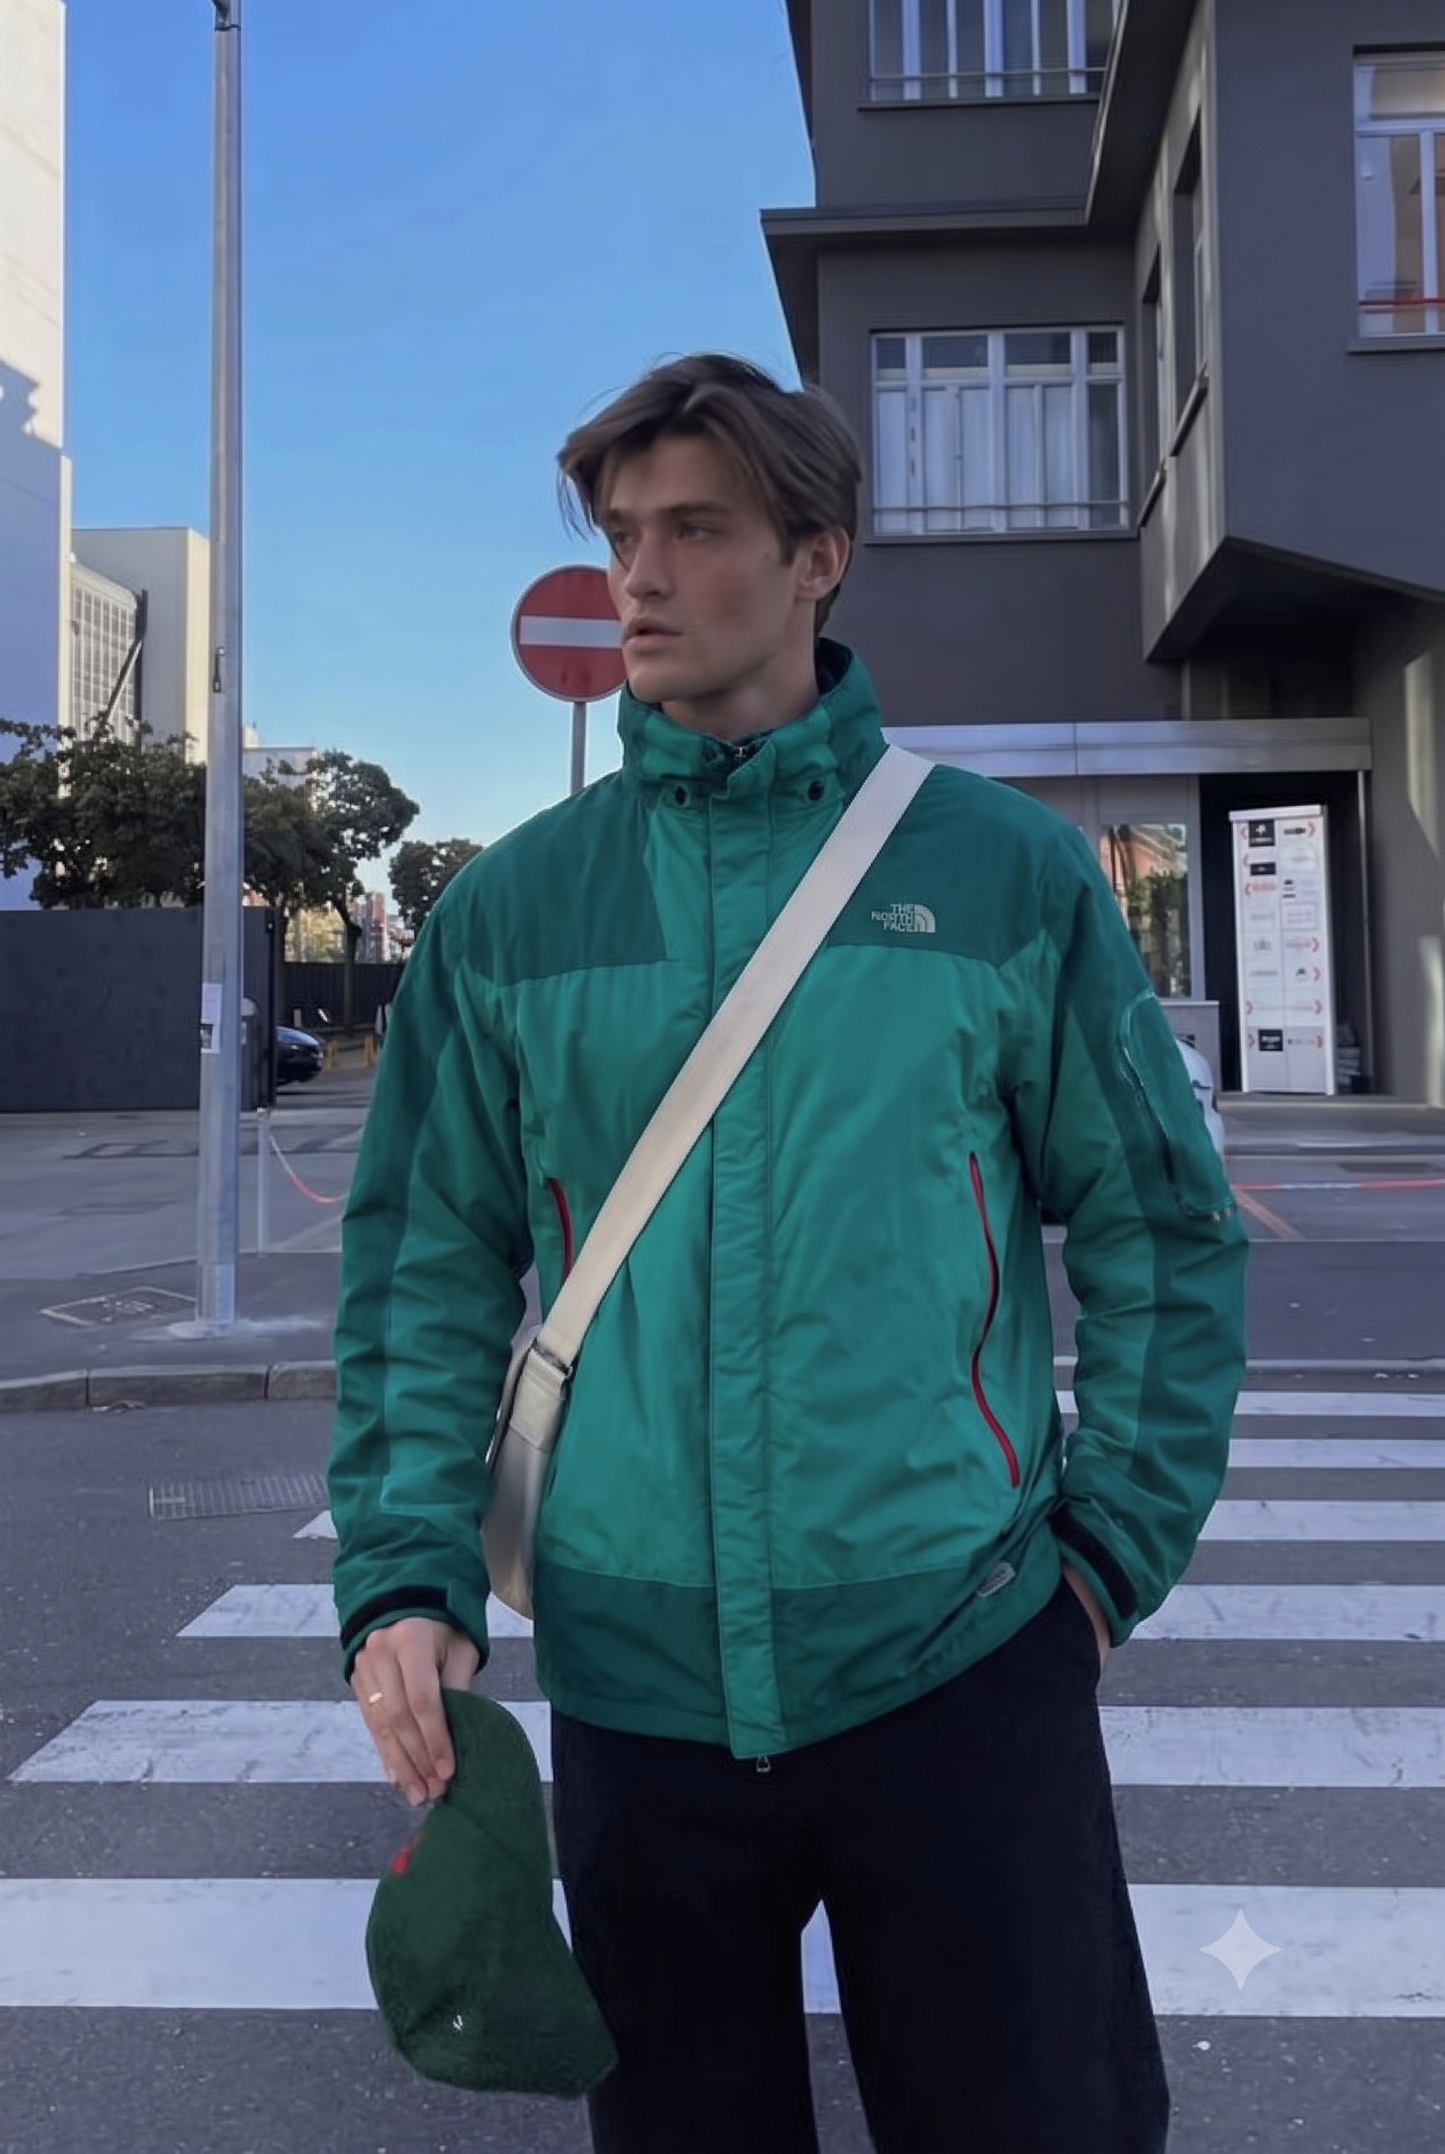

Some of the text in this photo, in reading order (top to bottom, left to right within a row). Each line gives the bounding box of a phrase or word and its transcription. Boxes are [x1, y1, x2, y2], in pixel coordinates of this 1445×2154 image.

[890, 903, 914, 914] THE
[871, 911, 913, 925] NORTH
[883, 921, 914, 932] FACE
